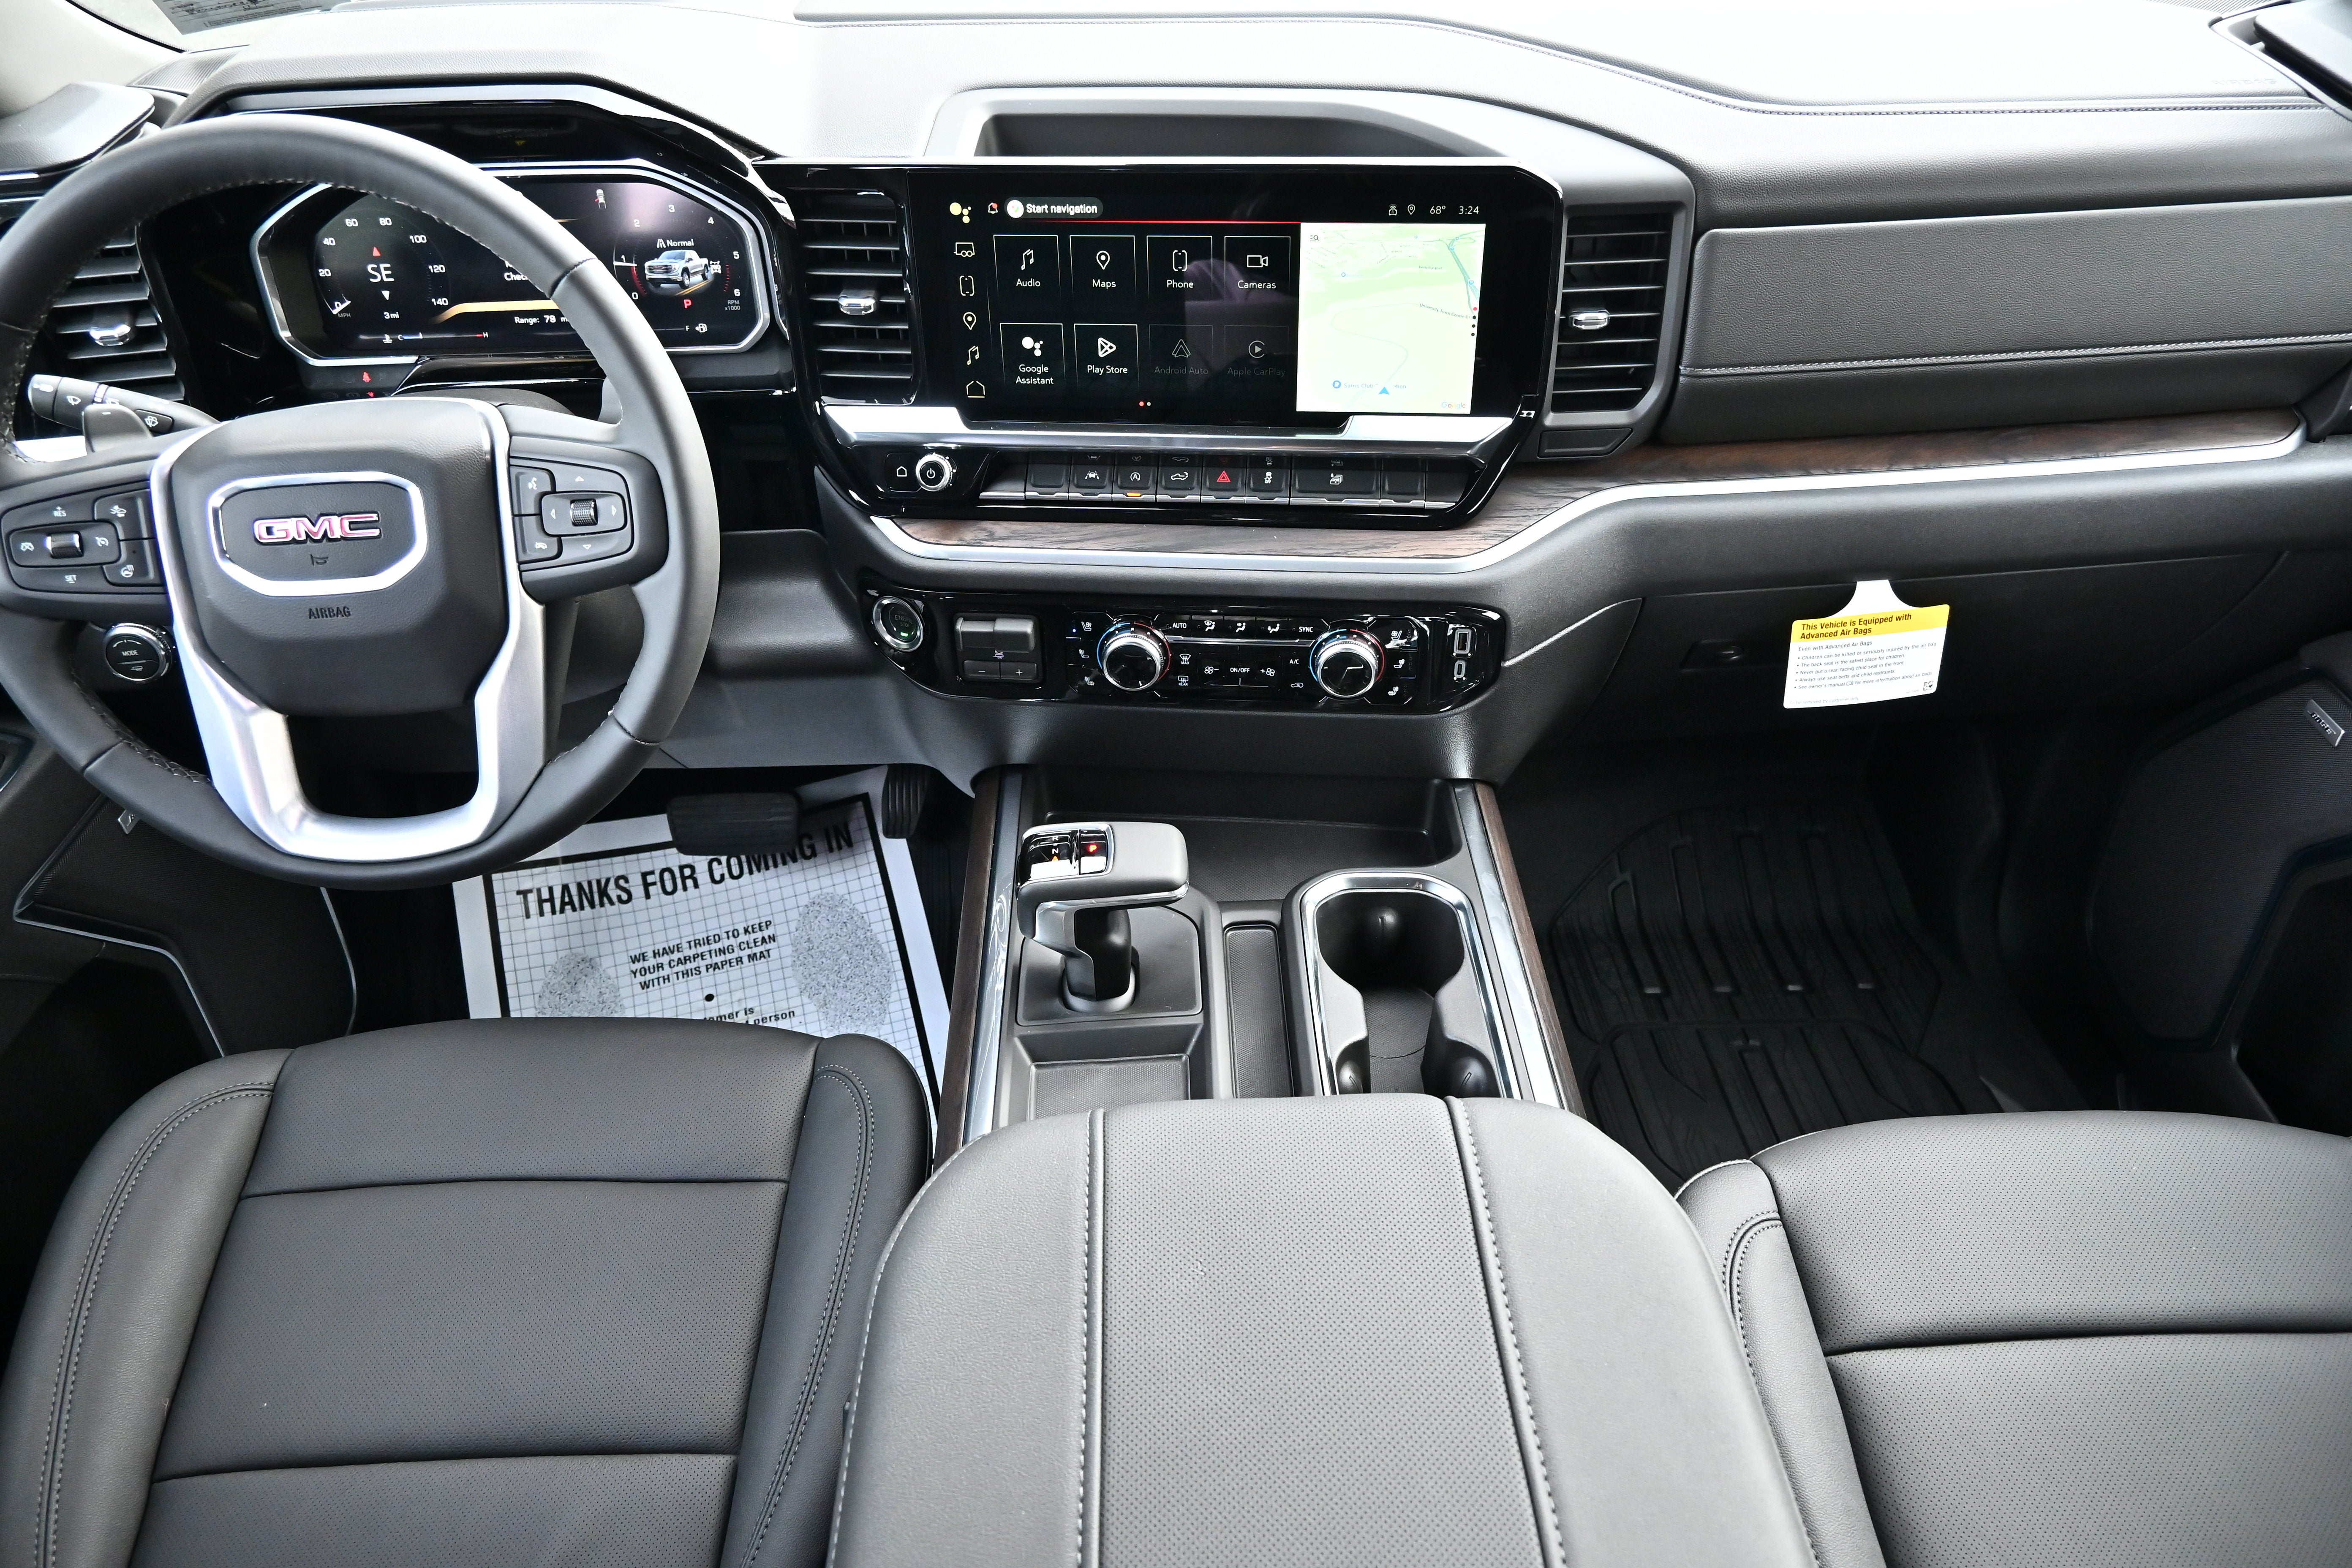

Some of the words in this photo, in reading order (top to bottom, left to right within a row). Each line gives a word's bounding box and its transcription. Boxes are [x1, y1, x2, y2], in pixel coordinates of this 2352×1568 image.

[669, 204, 675, 212] 3
[1026, 203, 1049, 214] Start
[1051, 203, 1097, 215] navigation
[1430, 206, 1446, 214] 68°
[1459, 206, 1479, 215] 3:24
[346, 218, 358, 227] 60
[379, 218, 392, 226] 80
[634, 219, 640, 227] 2
[708, 217, 714, 225] 4
[323, 237, 336, 246] 40
[409, 235, 427, 243] 100
[667, 238, 694, 247] Normal
[621, 255, 626, 263] 1
[733, 251, 740, 259] 5
[318, 269, 331, 277] 20
[367, 263, 395, 282] SE
[428, 265, 446, 273] 120
[504, 272, 528, 281] Chec
[1016, 278, 1040, 287] Audio
[1092, 279, 1116, 289] Maps
[1167, 279, 1194, 288] Phone
[1238, 280, 1276, 289] Cameras
[431, 298, 449, 306] 140
[683, 299, 692, 309] P
[514, 316, 540, 325] Range:
[544, 315, 556, 323] 79
[1019, 364, 1049, 374] Google
[1087, 365, 1104, 375] Play
[1106, 365, 1128, 373] Store
[1154, 366, 1187, 375] Android
[1227, 367, 1251, 377] Apple
[1254, 367, 1285, 378] CarPlay
[1015, 376, 1054, 384] Assistant
[1441, 401, 1466, 409] Google
[253, 514, 381, 543] GMC
[308, 606, 351, 619] AIRBAG
[1820, 621, 1848, 629] Vehicle
[1850, 619, 1856, 627] is
[1858, 615, 1893, 627] Equipped
[1895, 613, 1912, 621] with
[1800, 631, 1838, 640] Advanced
[1853, 627, 1872, 636] Bags
[1089, 844, 1097, 852] P
[516, 874, 633, 920] THANKS
[641, 863, 700, 900] FOR
[825, 821, 854, 853] IN
[629, 951, 648, 965] WE
[653, 943, 683, 960] HAVE
[686, 933, 721, 950] TRIED
[724, 928, 740, 940] TO
[743, 920, 773, 936] KEEP
[630, 962, 665, 979] YOUR
[668, 944, 735, 969] CARPETING
[738, 933, 776, 951] CLEAN
[639, 974, 671, 991] WITH
[675, 966, 702, 981] THIS
[705, 956, 744, 973] PAPER
[747, 948, 772, 964] MAT
[744, 1007, 754, 1016] is
[754, 1010, 795, 1025] person
